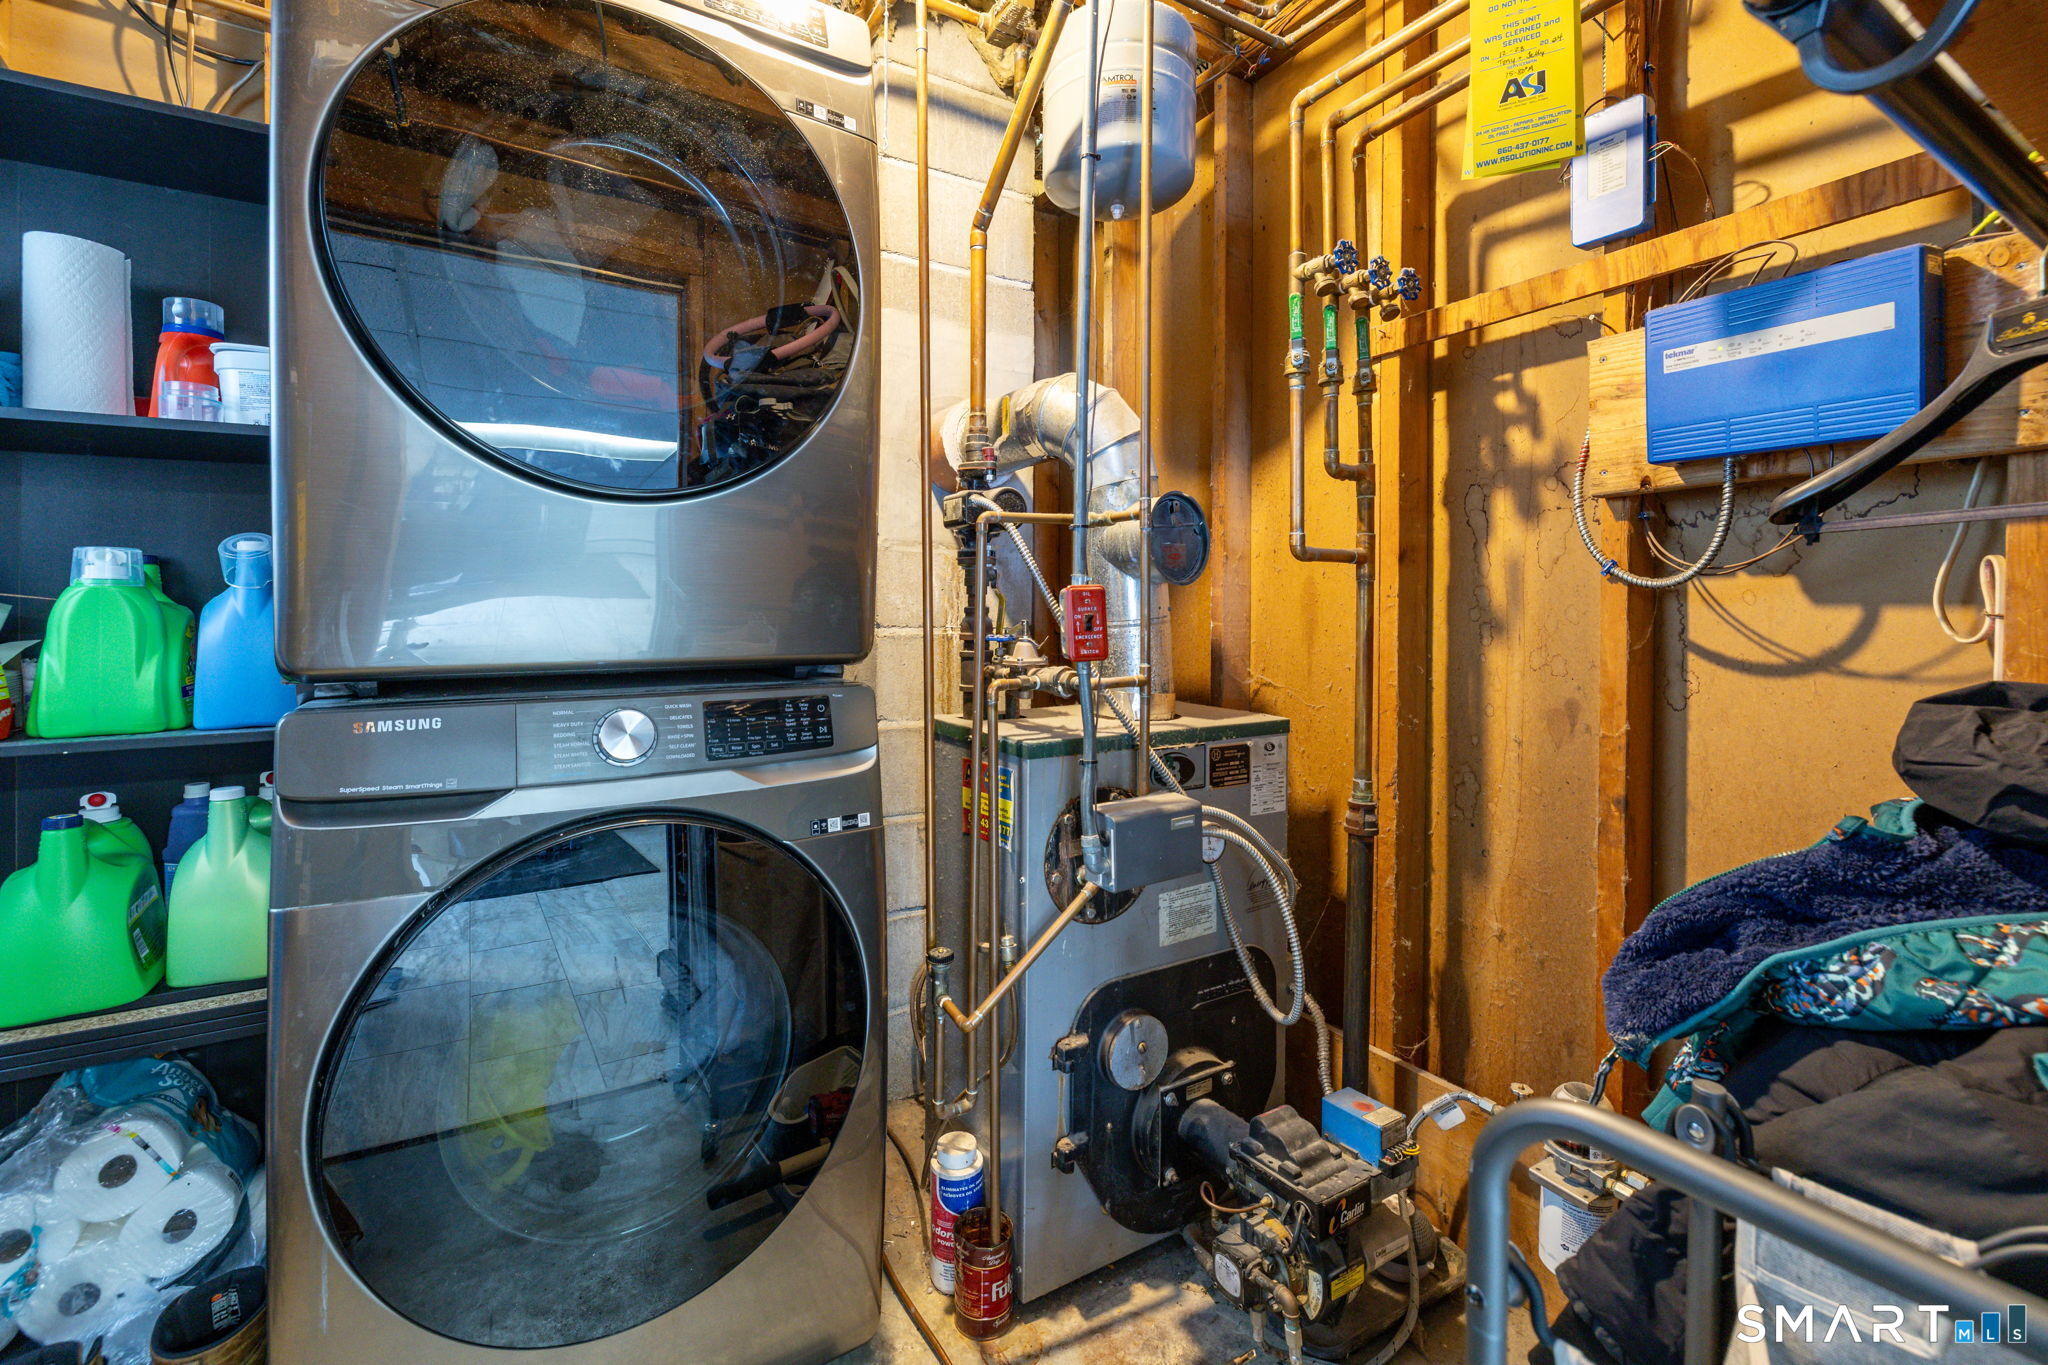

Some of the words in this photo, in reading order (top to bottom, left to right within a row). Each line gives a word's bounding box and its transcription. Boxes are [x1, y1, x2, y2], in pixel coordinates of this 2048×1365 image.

[1488, 4, 1499, 12] DO
[1483, 34, 1502, 44] WAS
[1506, 22, 1541, 38] CLEANED
[1544, 16, 1560, 27] and
[1502, 20, 1520, 30] THIS
[1522, 14, 1542, 24] UNIT
[1502, 32, 1541, 47] SERVICED
[1500, 70, 1546, 104] ASI
[1497, 137, 1550, 154] 860-437-0177
[1664, 348, 1696, 360] tekmar
[352, 717, 442, 734] SAMSUNG
[158, 1074, 194, 1096] Soft
[1340, 1202, 1365, 1224] Carlin
